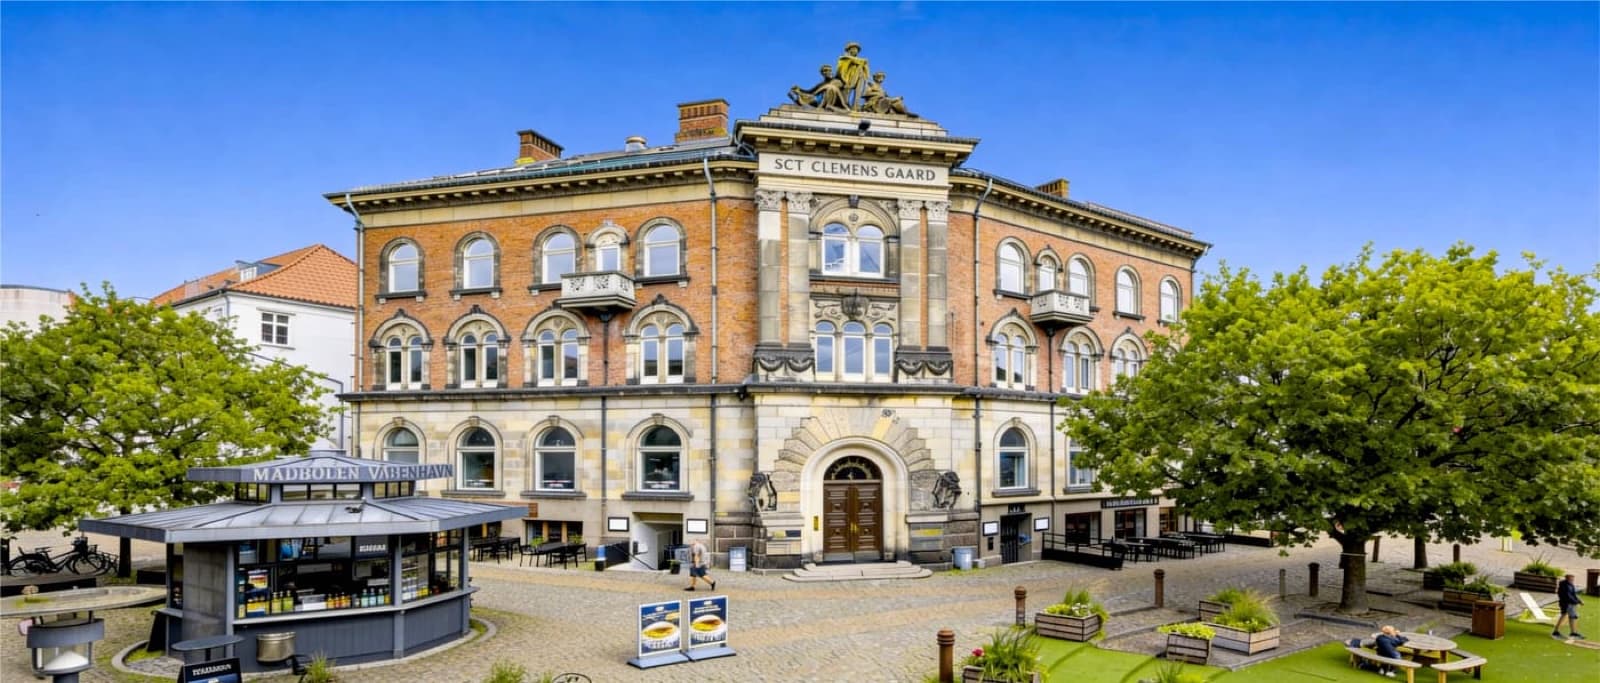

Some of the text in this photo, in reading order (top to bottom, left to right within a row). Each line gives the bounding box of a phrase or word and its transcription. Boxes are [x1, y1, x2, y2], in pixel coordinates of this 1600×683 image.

[775, 158, 936, 181] SCT CLEMENS GAARD
